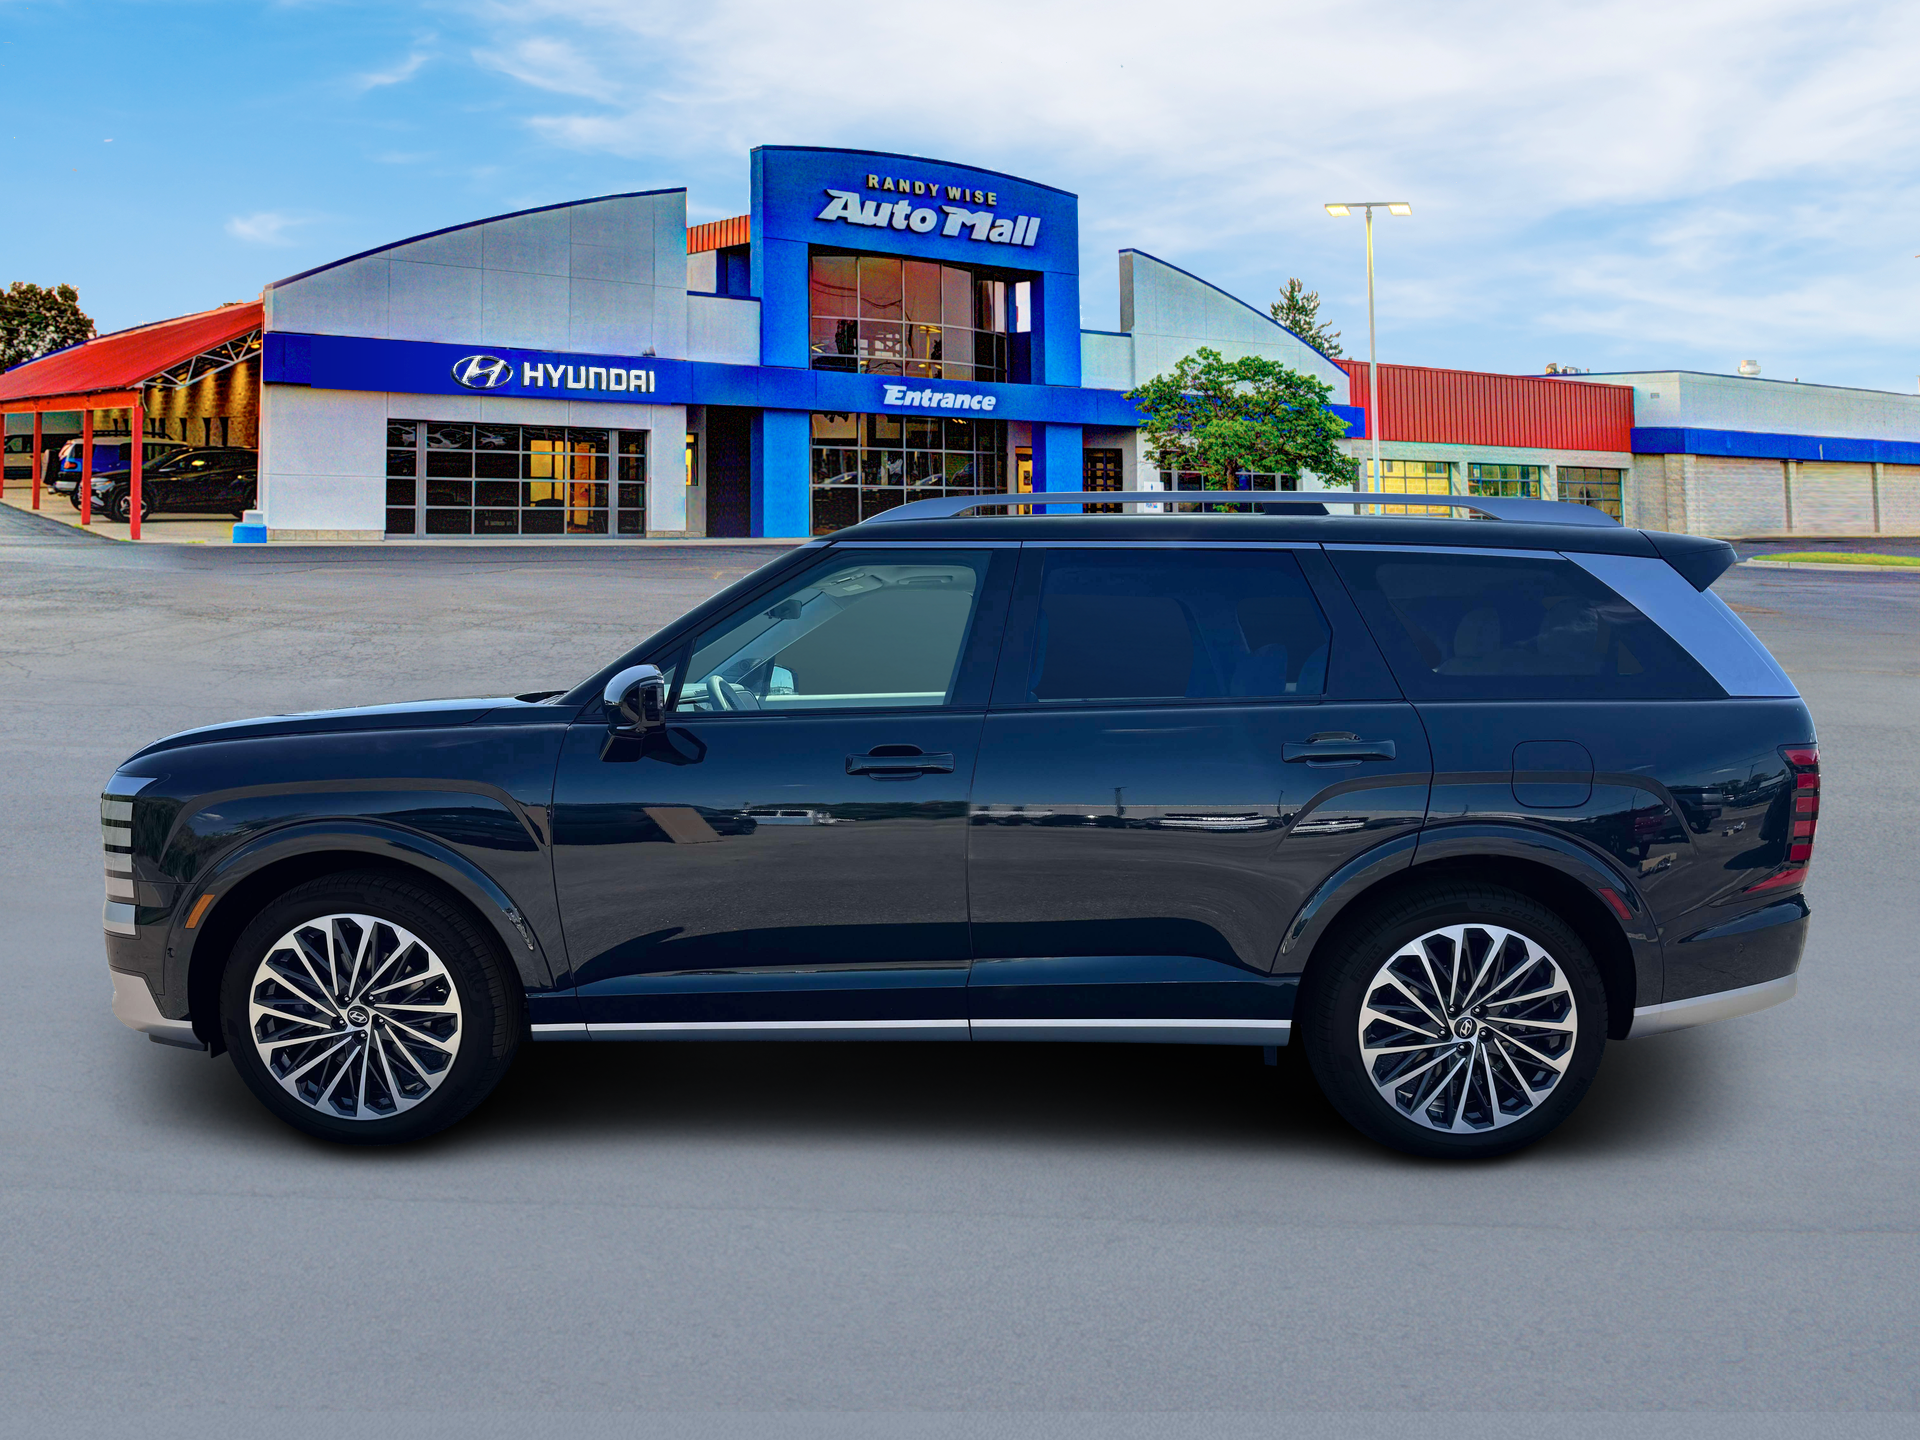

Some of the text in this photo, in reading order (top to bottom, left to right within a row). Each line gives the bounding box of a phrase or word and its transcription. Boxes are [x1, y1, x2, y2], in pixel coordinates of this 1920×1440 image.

[867, 173, 998, 206] RANDY WISE
[815, 188, 1041, 247] Auto Mall
[522, 361, 656, 393] HYUNDAI
[882, 384, 997, 411] Entrance
